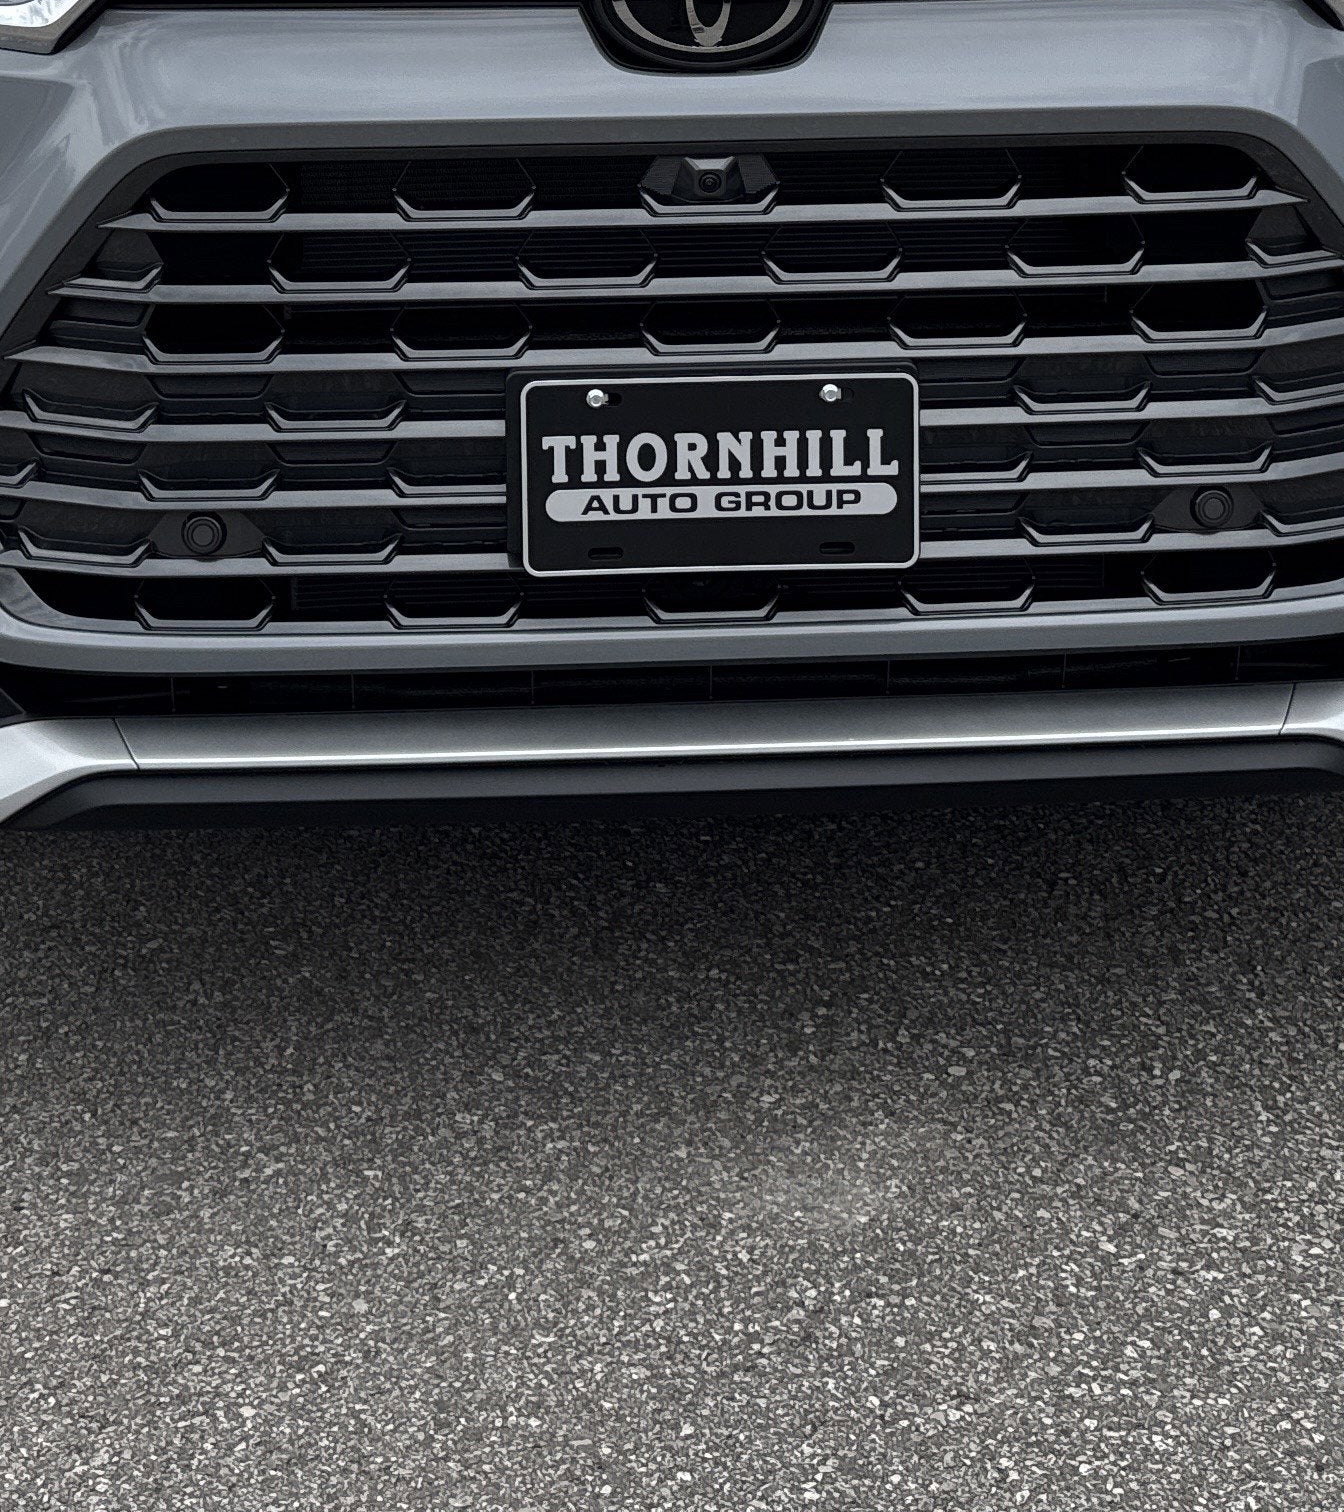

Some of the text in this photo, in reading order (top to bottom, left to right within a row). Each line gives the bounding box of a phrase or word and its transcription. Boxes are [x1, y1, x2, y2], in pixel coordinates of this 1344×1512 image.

[542, 429, 899, 483] THORNHILL
[581, 489, 862, 516] AUTO GROUP
